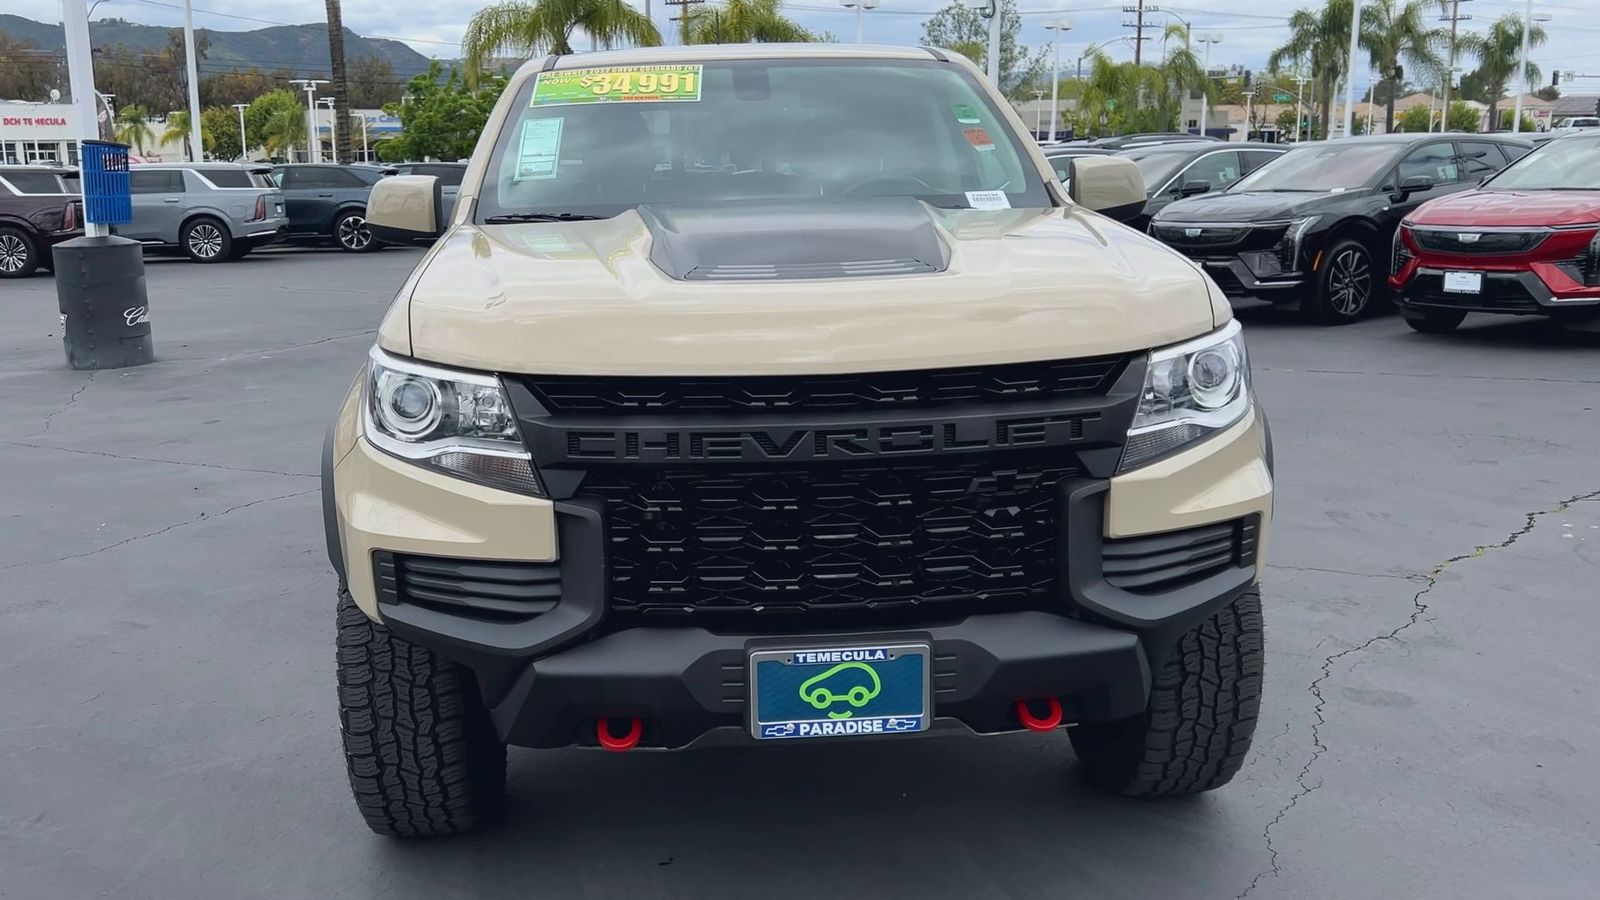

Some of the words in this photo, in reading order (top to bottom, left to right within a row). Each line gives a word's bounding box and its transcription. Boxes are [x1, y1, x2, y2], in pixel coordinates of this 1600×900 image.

[580, 72, 695, 95] $34,991
[566, 416, 1102, 459] CHEVROLET
[796, 650, 885, 663] TEMECULA
[800, 719, 883, 736] PARADISE
